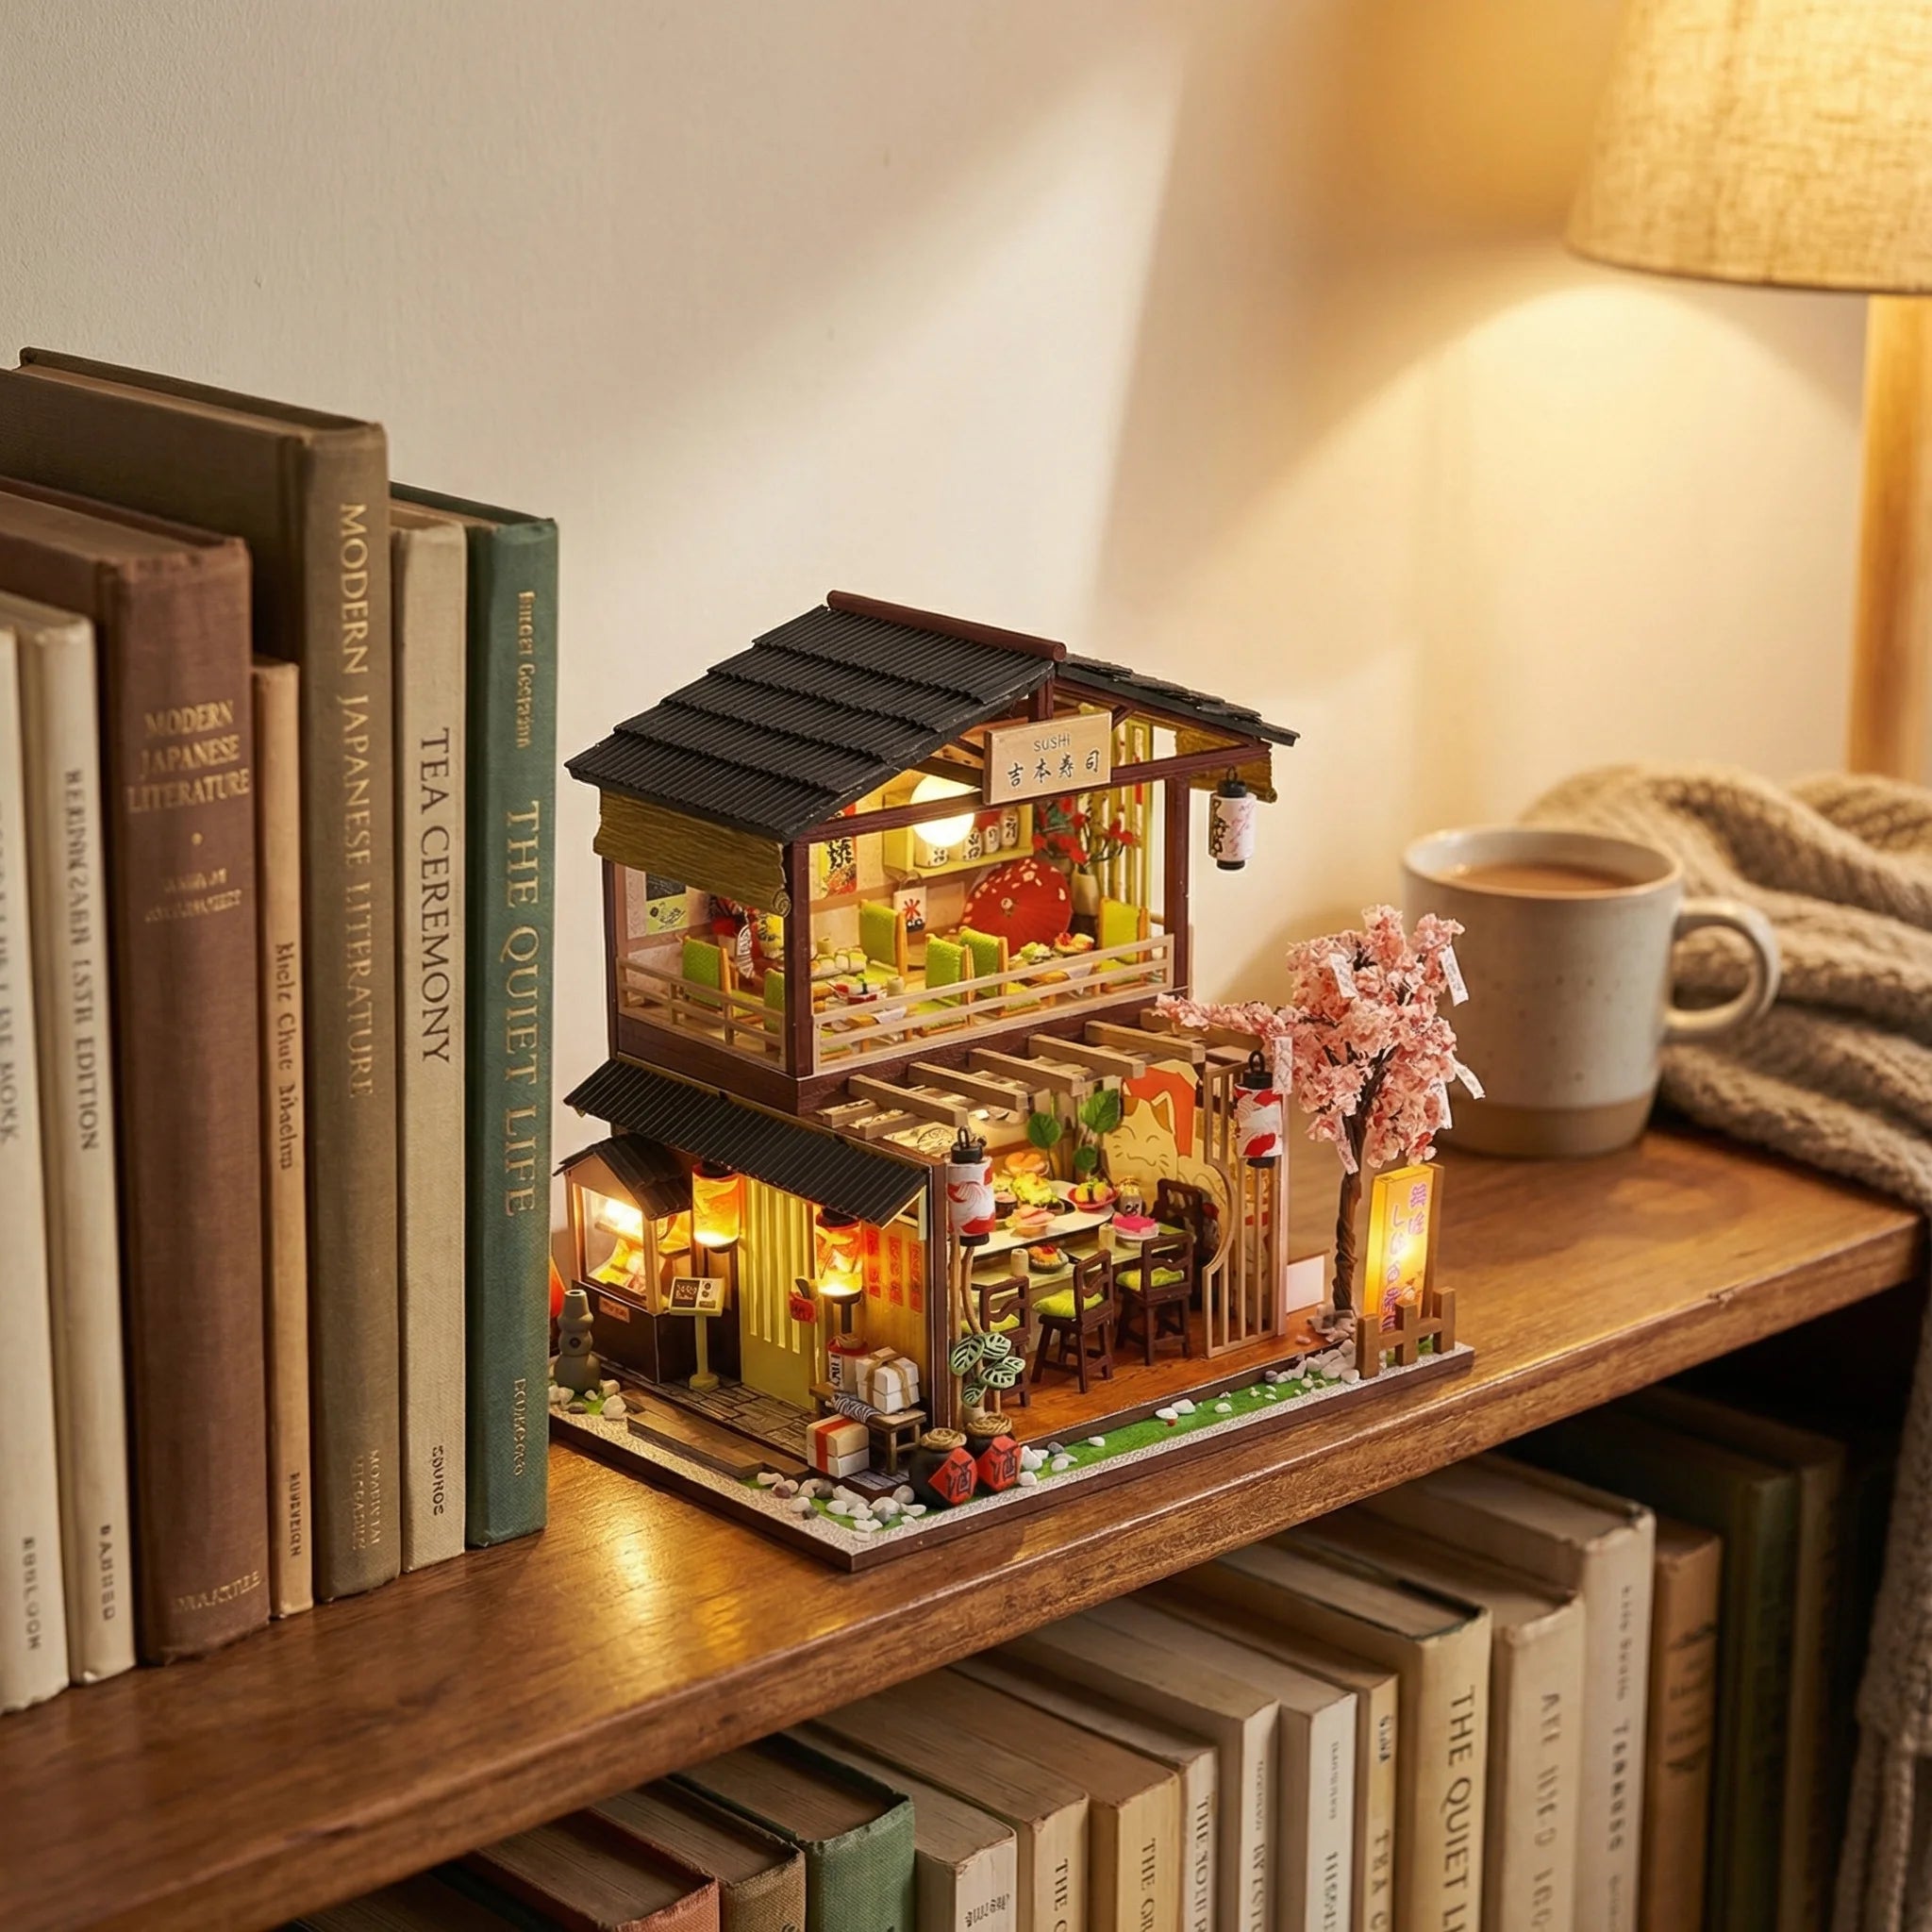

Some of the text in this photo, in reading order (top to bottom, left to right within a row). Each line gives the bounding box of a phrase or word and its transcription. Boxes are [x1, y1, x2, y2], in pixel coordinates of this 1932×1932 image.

[143, 700, 234, 739] MODERN
[126, 767, 250, 814] LITERATURE
[139, 734, 240, 779] JAPANESE
[340, 503, 375, 1098] MODERN JAPANESE LITERATURE
[419, 726, 451, 1065] TEA CEREMONY
[501, 799, 541, 1217] THE QUIET LIFE
[75, 1037, 99, 1151] EDITION
[1449, 1685, 1475, 1767] THE
[1195, 1795, 1209, 1850] THE
[1441, 1776, 1473, 1890] QUIET
[1054, 1857, 1069, 1911] THE
[1140, 1837, 1157, 1890] THE
